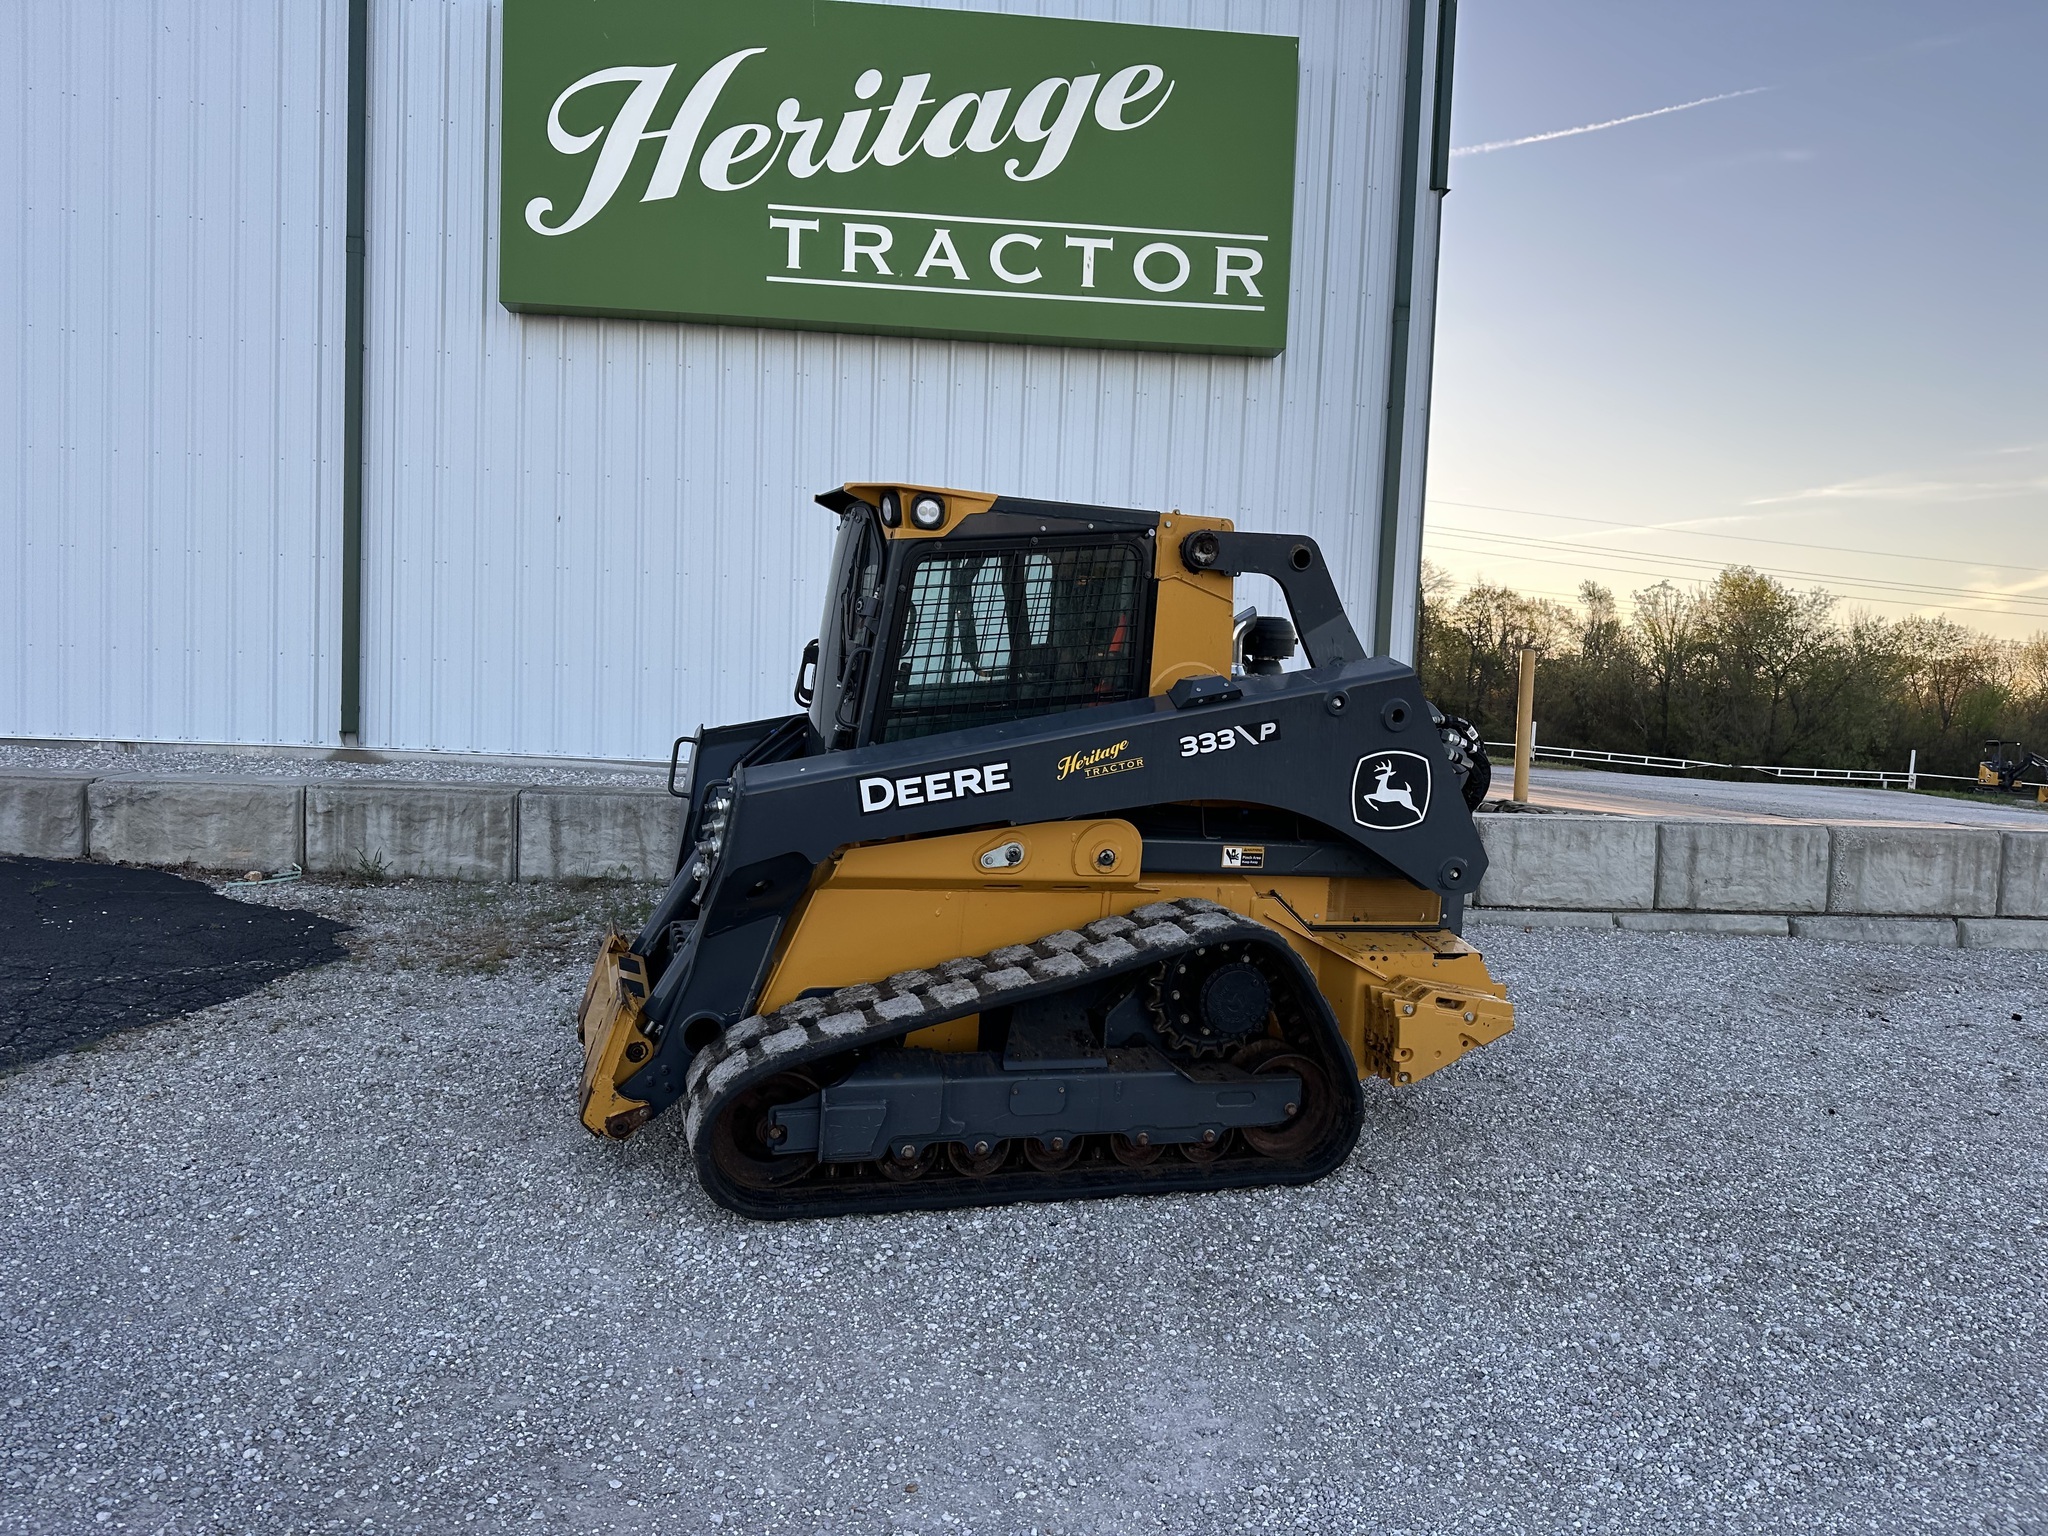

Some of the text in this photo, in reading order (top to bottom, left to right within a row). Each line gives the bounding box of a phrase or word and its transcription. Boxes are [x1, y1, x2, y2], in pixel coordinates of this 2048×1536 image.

[525, 47, 1175, 236] Heritage
[769, 215, 1264, 298] TRACTOR
[1056, 740, 1129, 781] Heritage
[1084, 759, 1144, 777] TRACTOR
[859, 762, 1011, 813] DEERE
